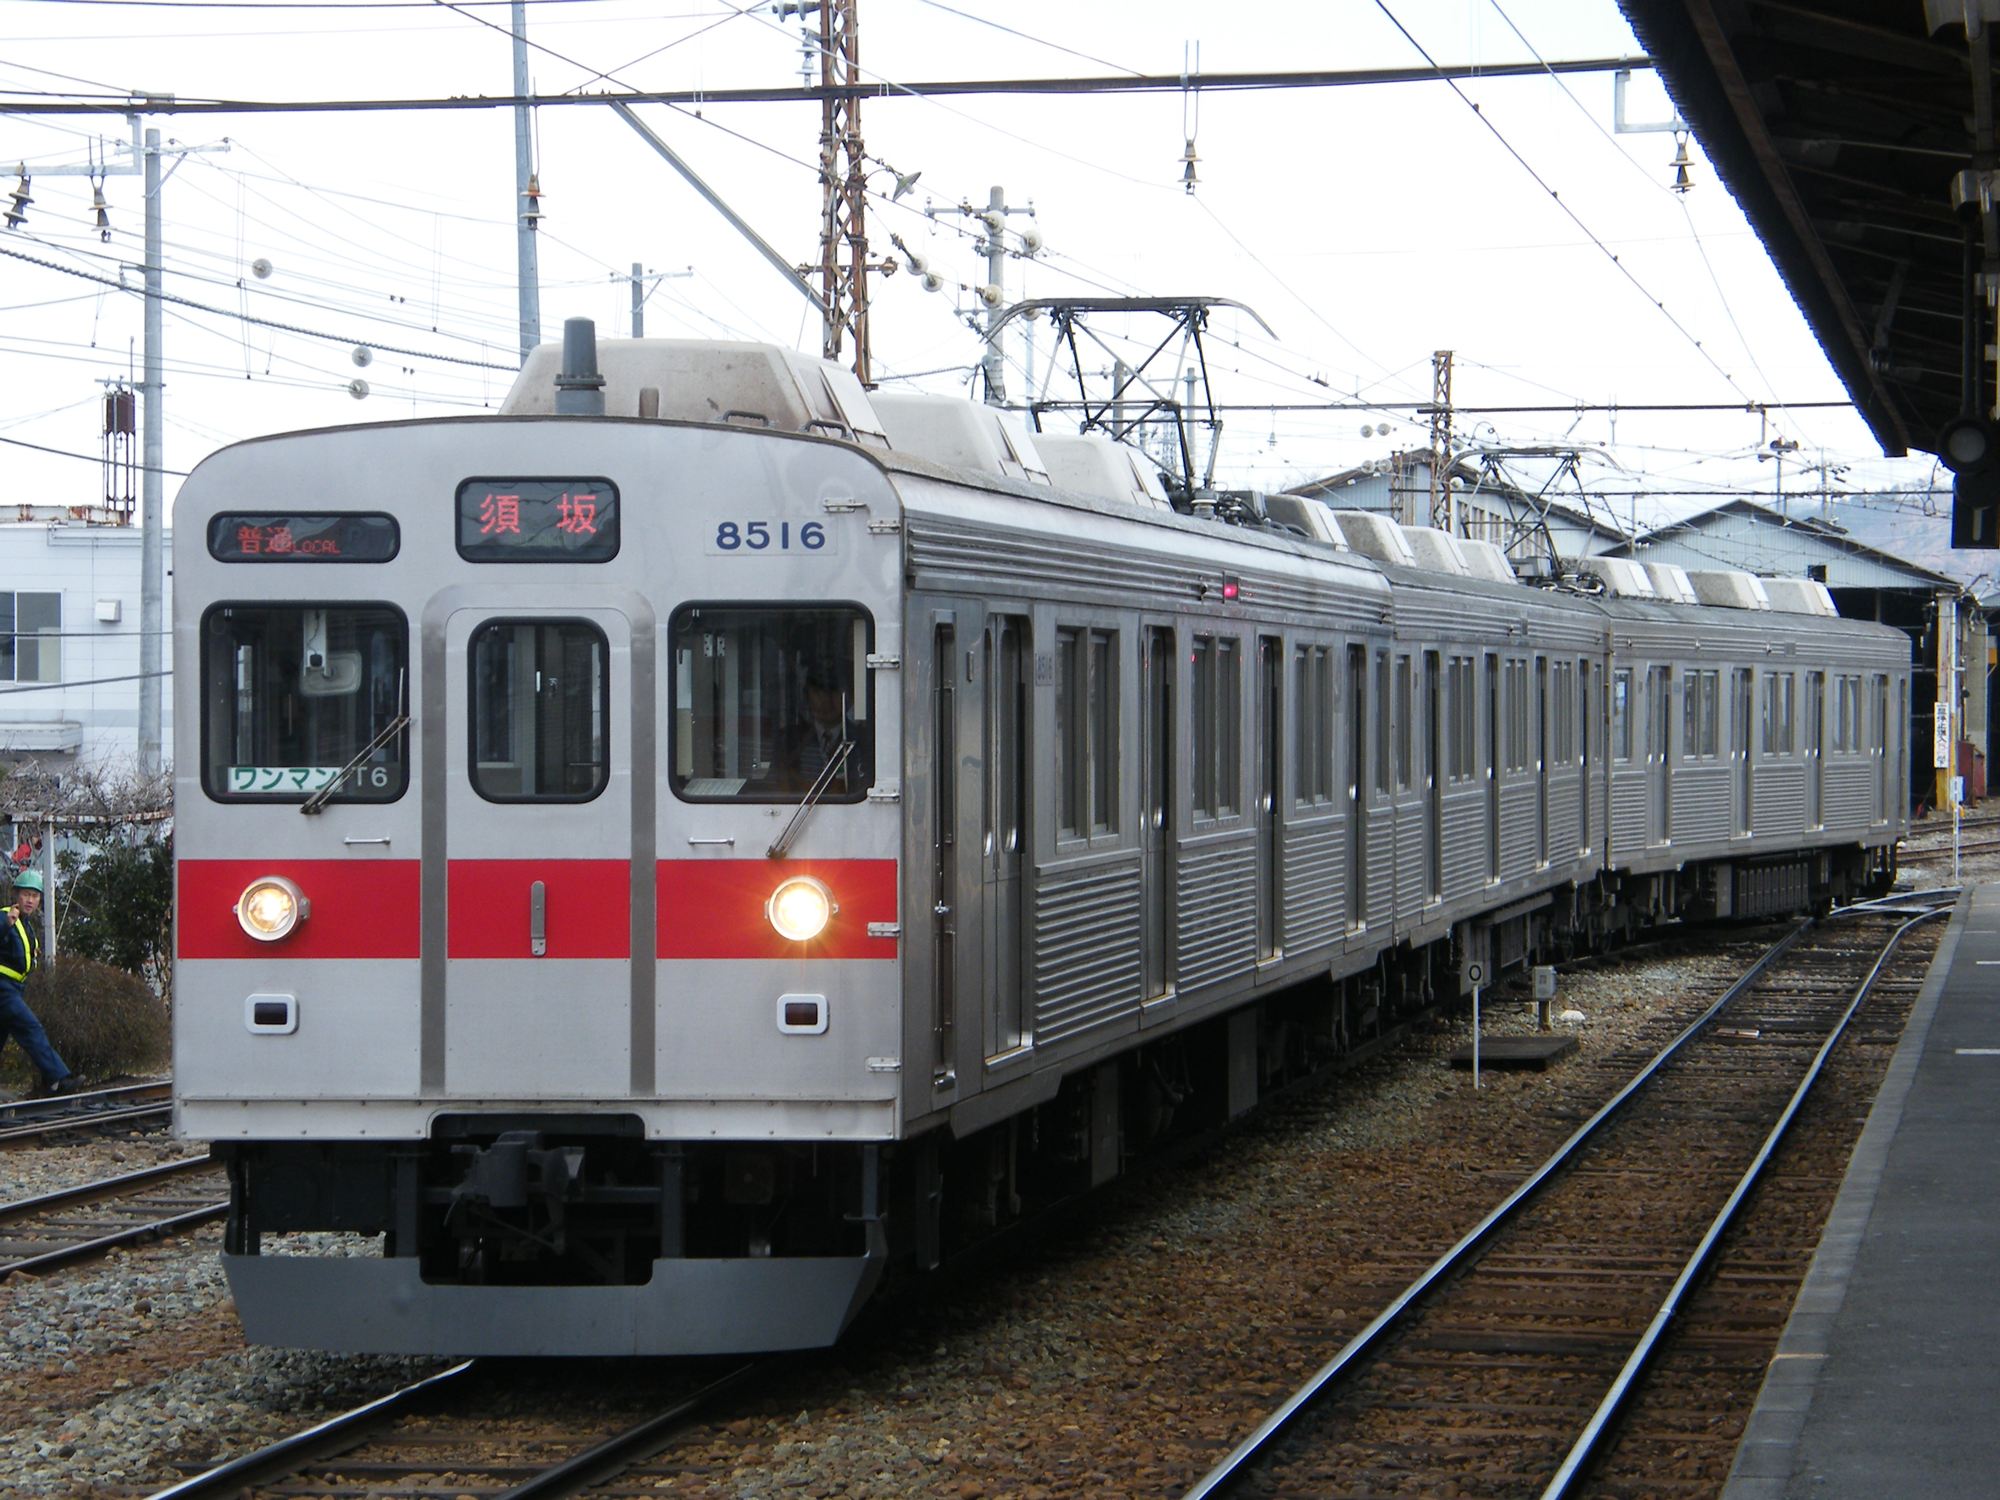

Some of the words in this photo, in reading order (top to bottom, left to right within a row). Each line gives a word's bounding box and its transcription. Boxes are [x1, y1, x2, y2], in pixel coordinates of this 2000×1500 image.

[480, 493, 597, 534] 須坂
[716, 521, 826, 550] 8516
[235, 768, 338, 790] ワンマン
[353, 767, 388, 787] T6
